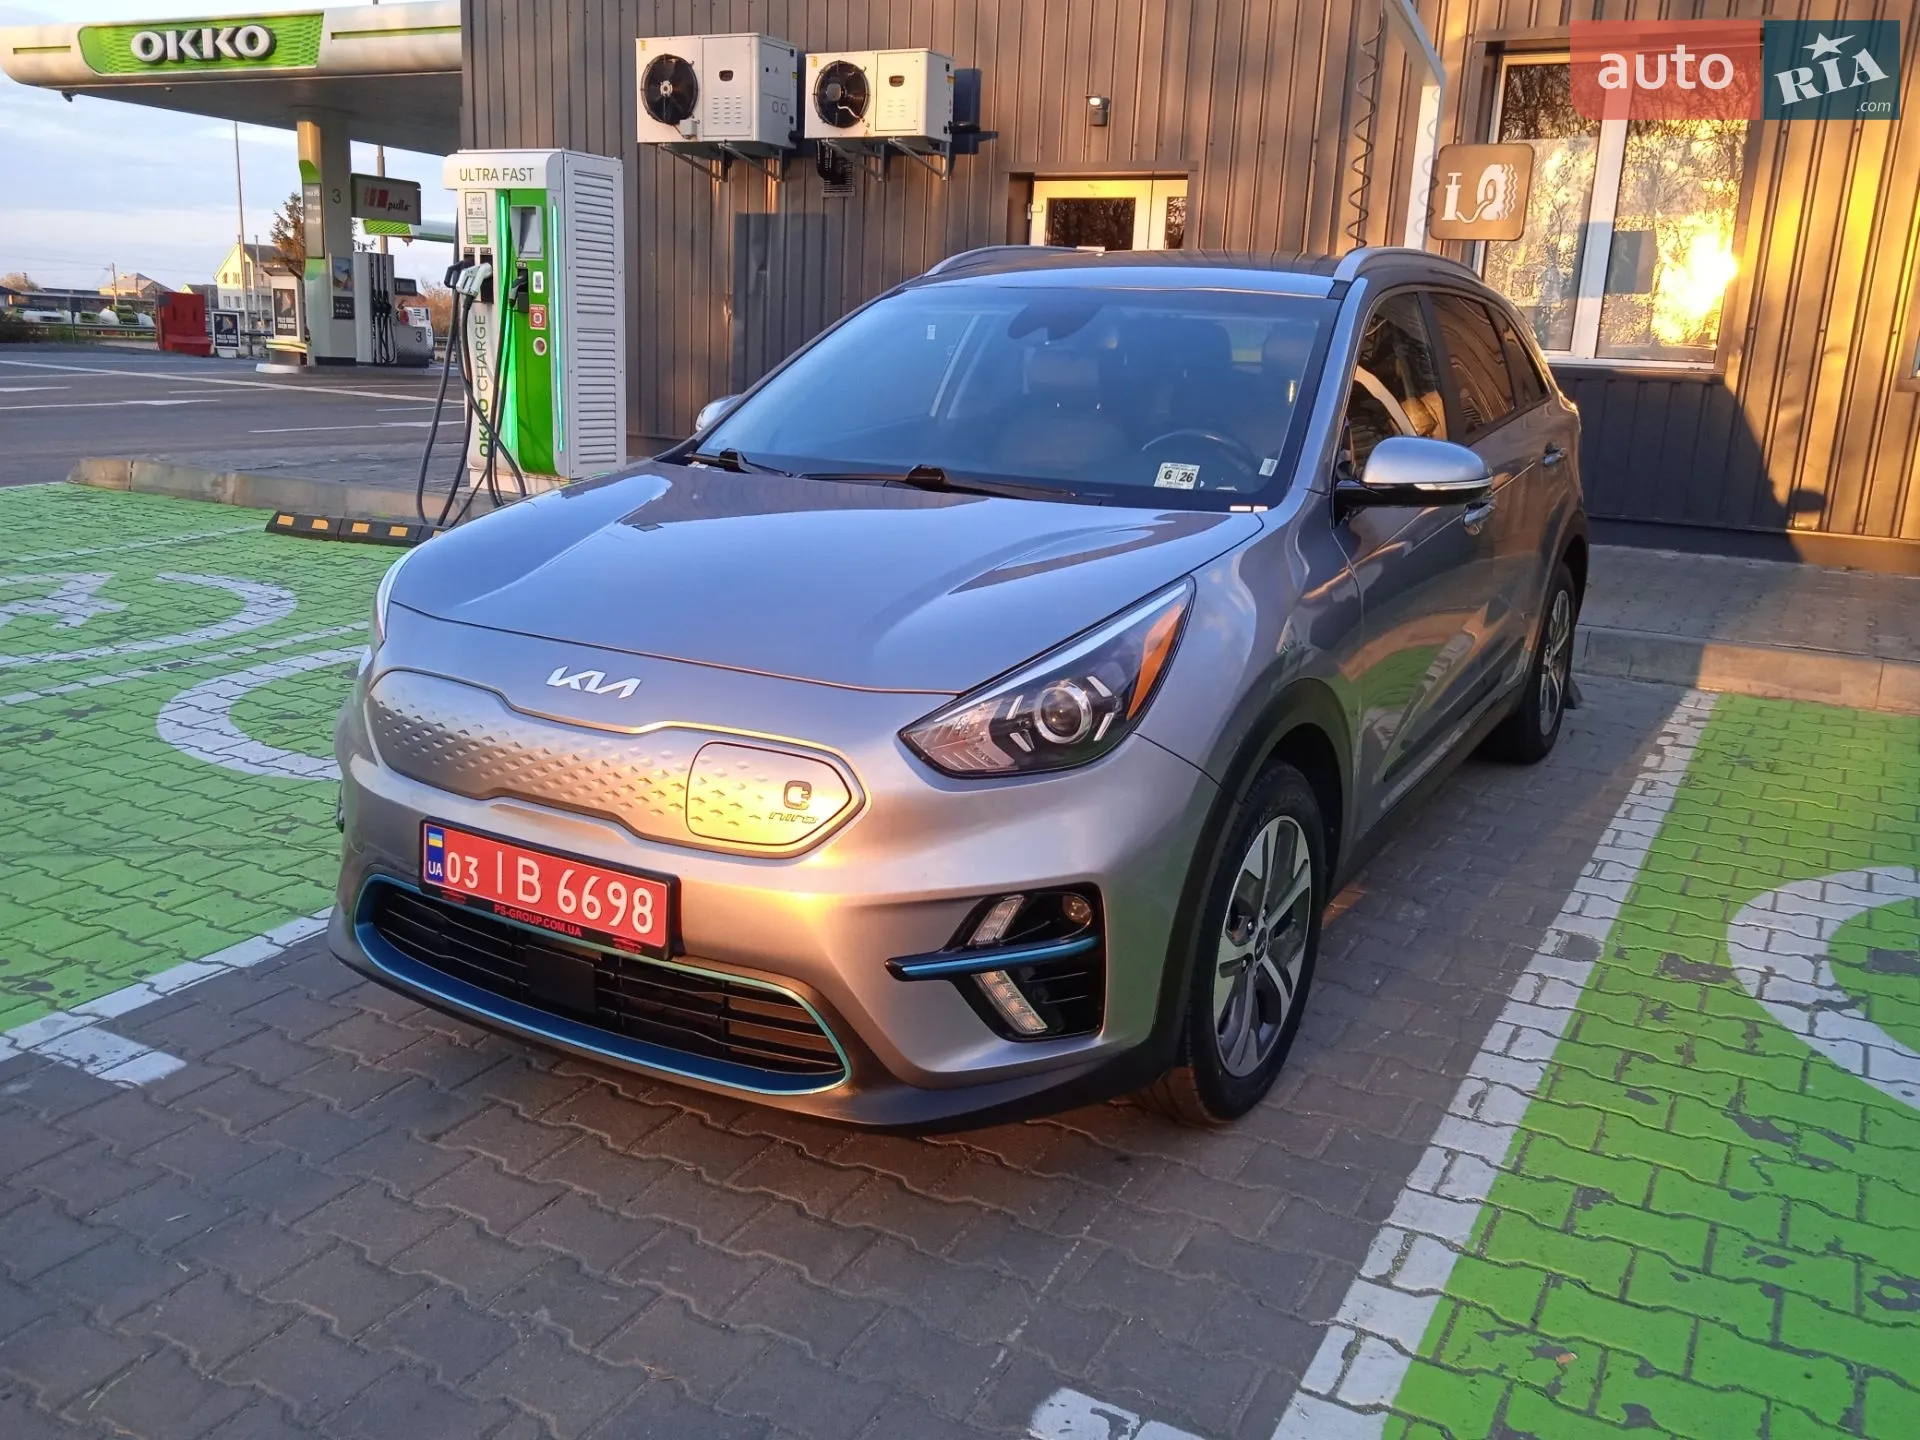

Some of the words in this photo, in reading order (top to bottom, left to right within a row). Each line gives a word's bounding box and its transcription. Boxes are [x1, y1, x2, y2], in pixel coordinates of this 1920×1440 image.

[131, 25, 271, 62] OKKO
[459, 168, 499, 182] ULTRA
[502, 167, 534, 182] FAST
[331, 188, 342, 204] 3
[415, 331, 422, 343] 3
[475, 314, 489, 391] CHARGE
[1164, 470, 1173, 480] 6
[1179, 472, 1194, 482] 26
[428, 860, 443, 877] UA
[446, 851, 478, 889] 03
[557, 869, 654, 934] 6698
[494, 903, 582, 937] PS-GROUP.COM.UA
